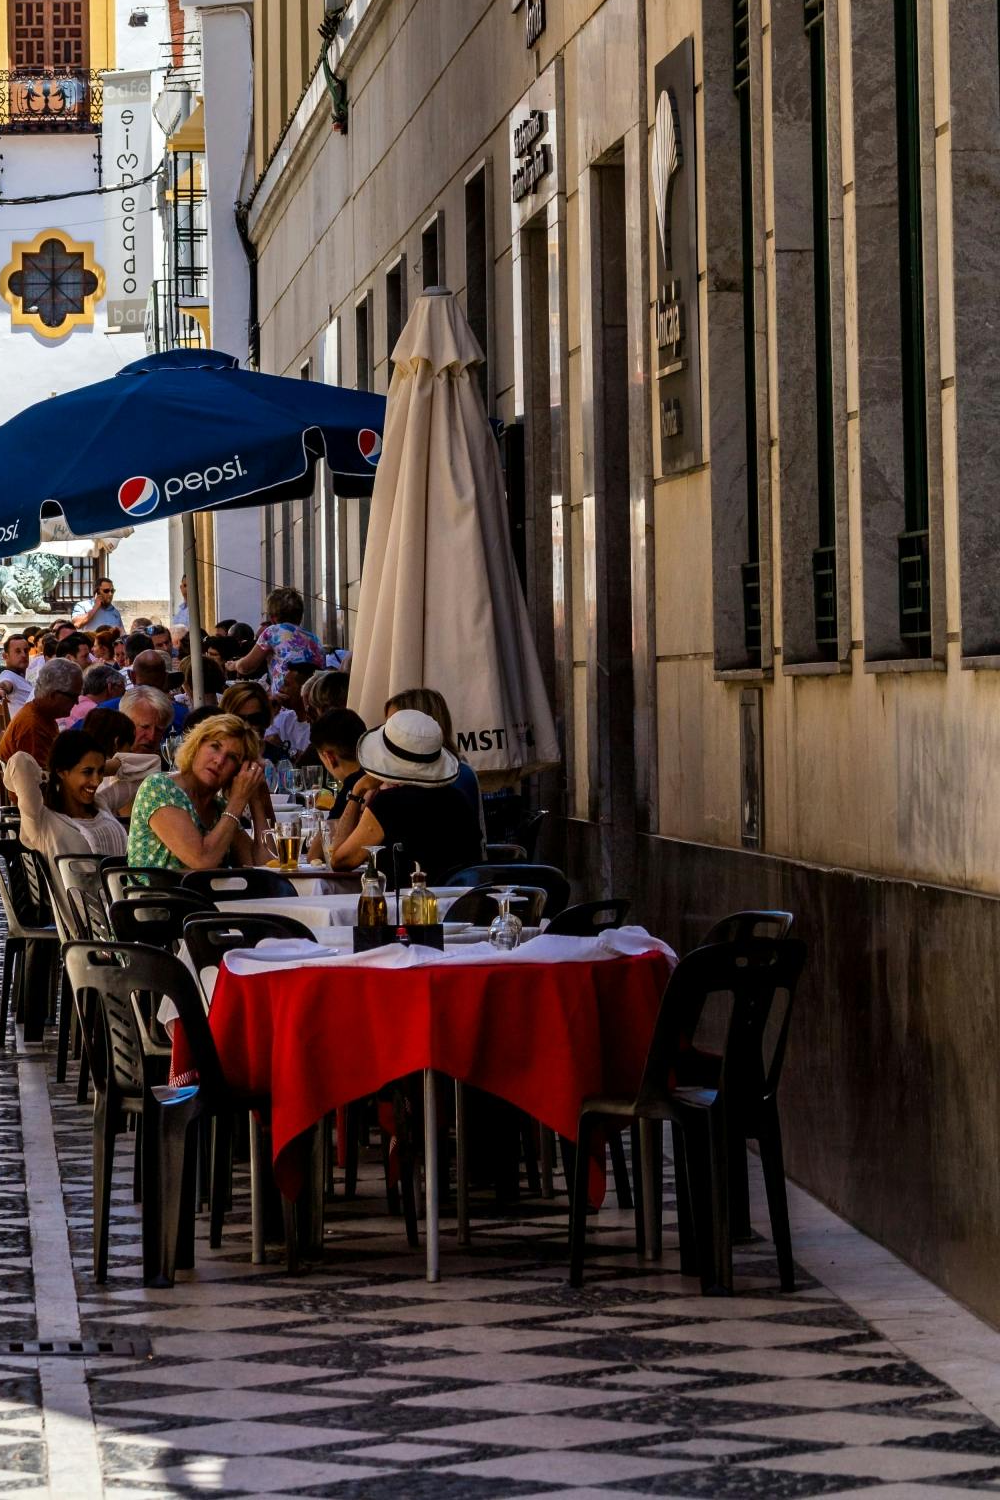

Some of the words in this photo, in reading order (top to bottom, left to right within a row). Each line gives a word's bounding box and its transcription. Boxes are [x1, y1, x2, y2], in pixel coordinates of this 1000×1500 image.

[653, 280, 681, 358] Unicaja
[164, 454, 247, 502] pepsi
[456, 728, 508, 752] MST
